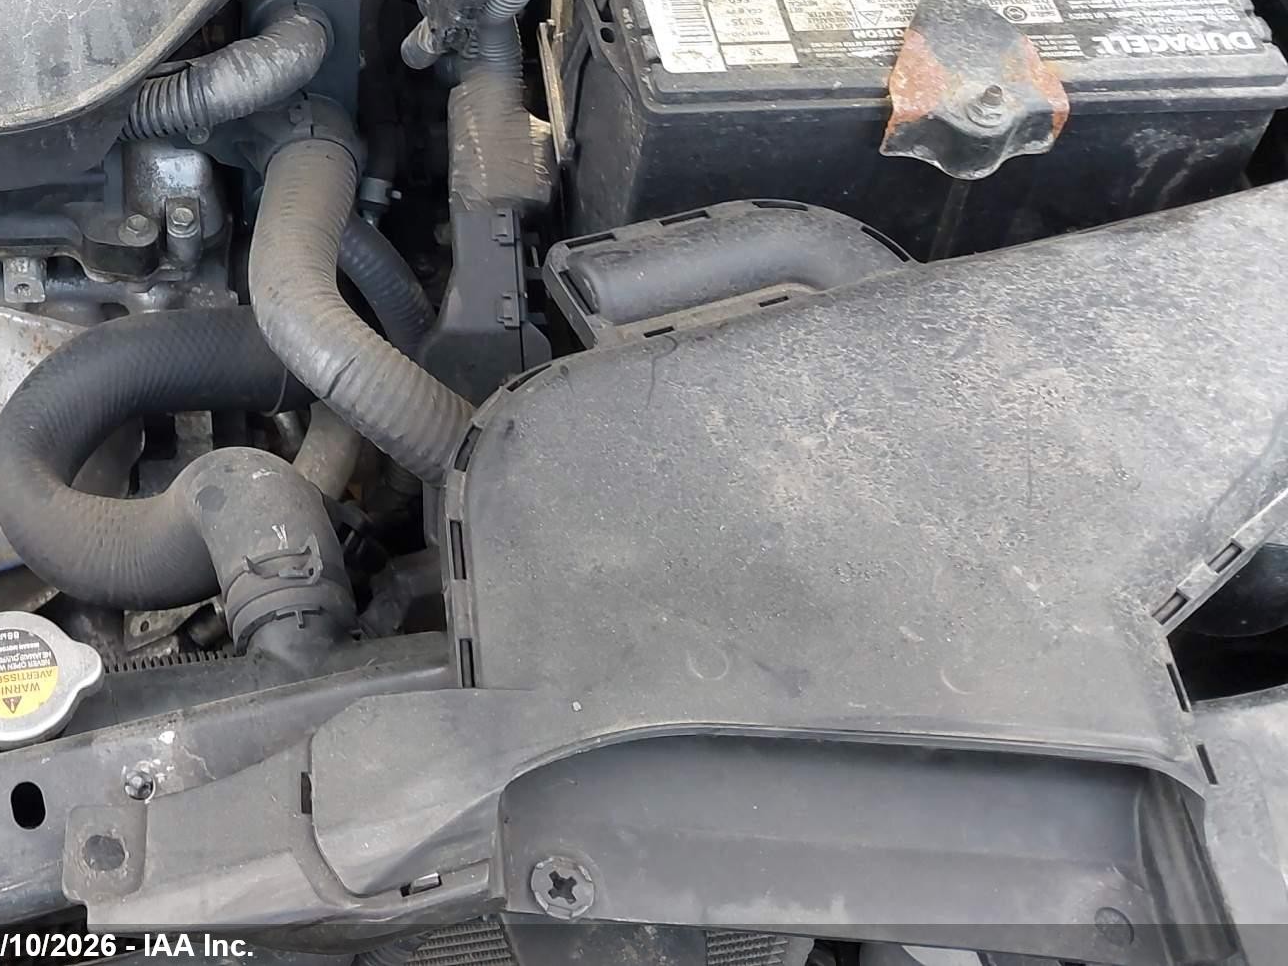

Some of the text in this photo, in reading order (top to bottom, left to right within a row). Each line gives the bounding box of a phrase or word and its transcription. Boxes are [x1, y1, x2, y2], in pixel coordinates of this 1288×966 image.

[853, 28, 905, 39] OISON
[1091, 31, 1257, 54] DURACELL
[7, 661, 26, 670] OPEN
[28, 659, 50, 668] NEVER
